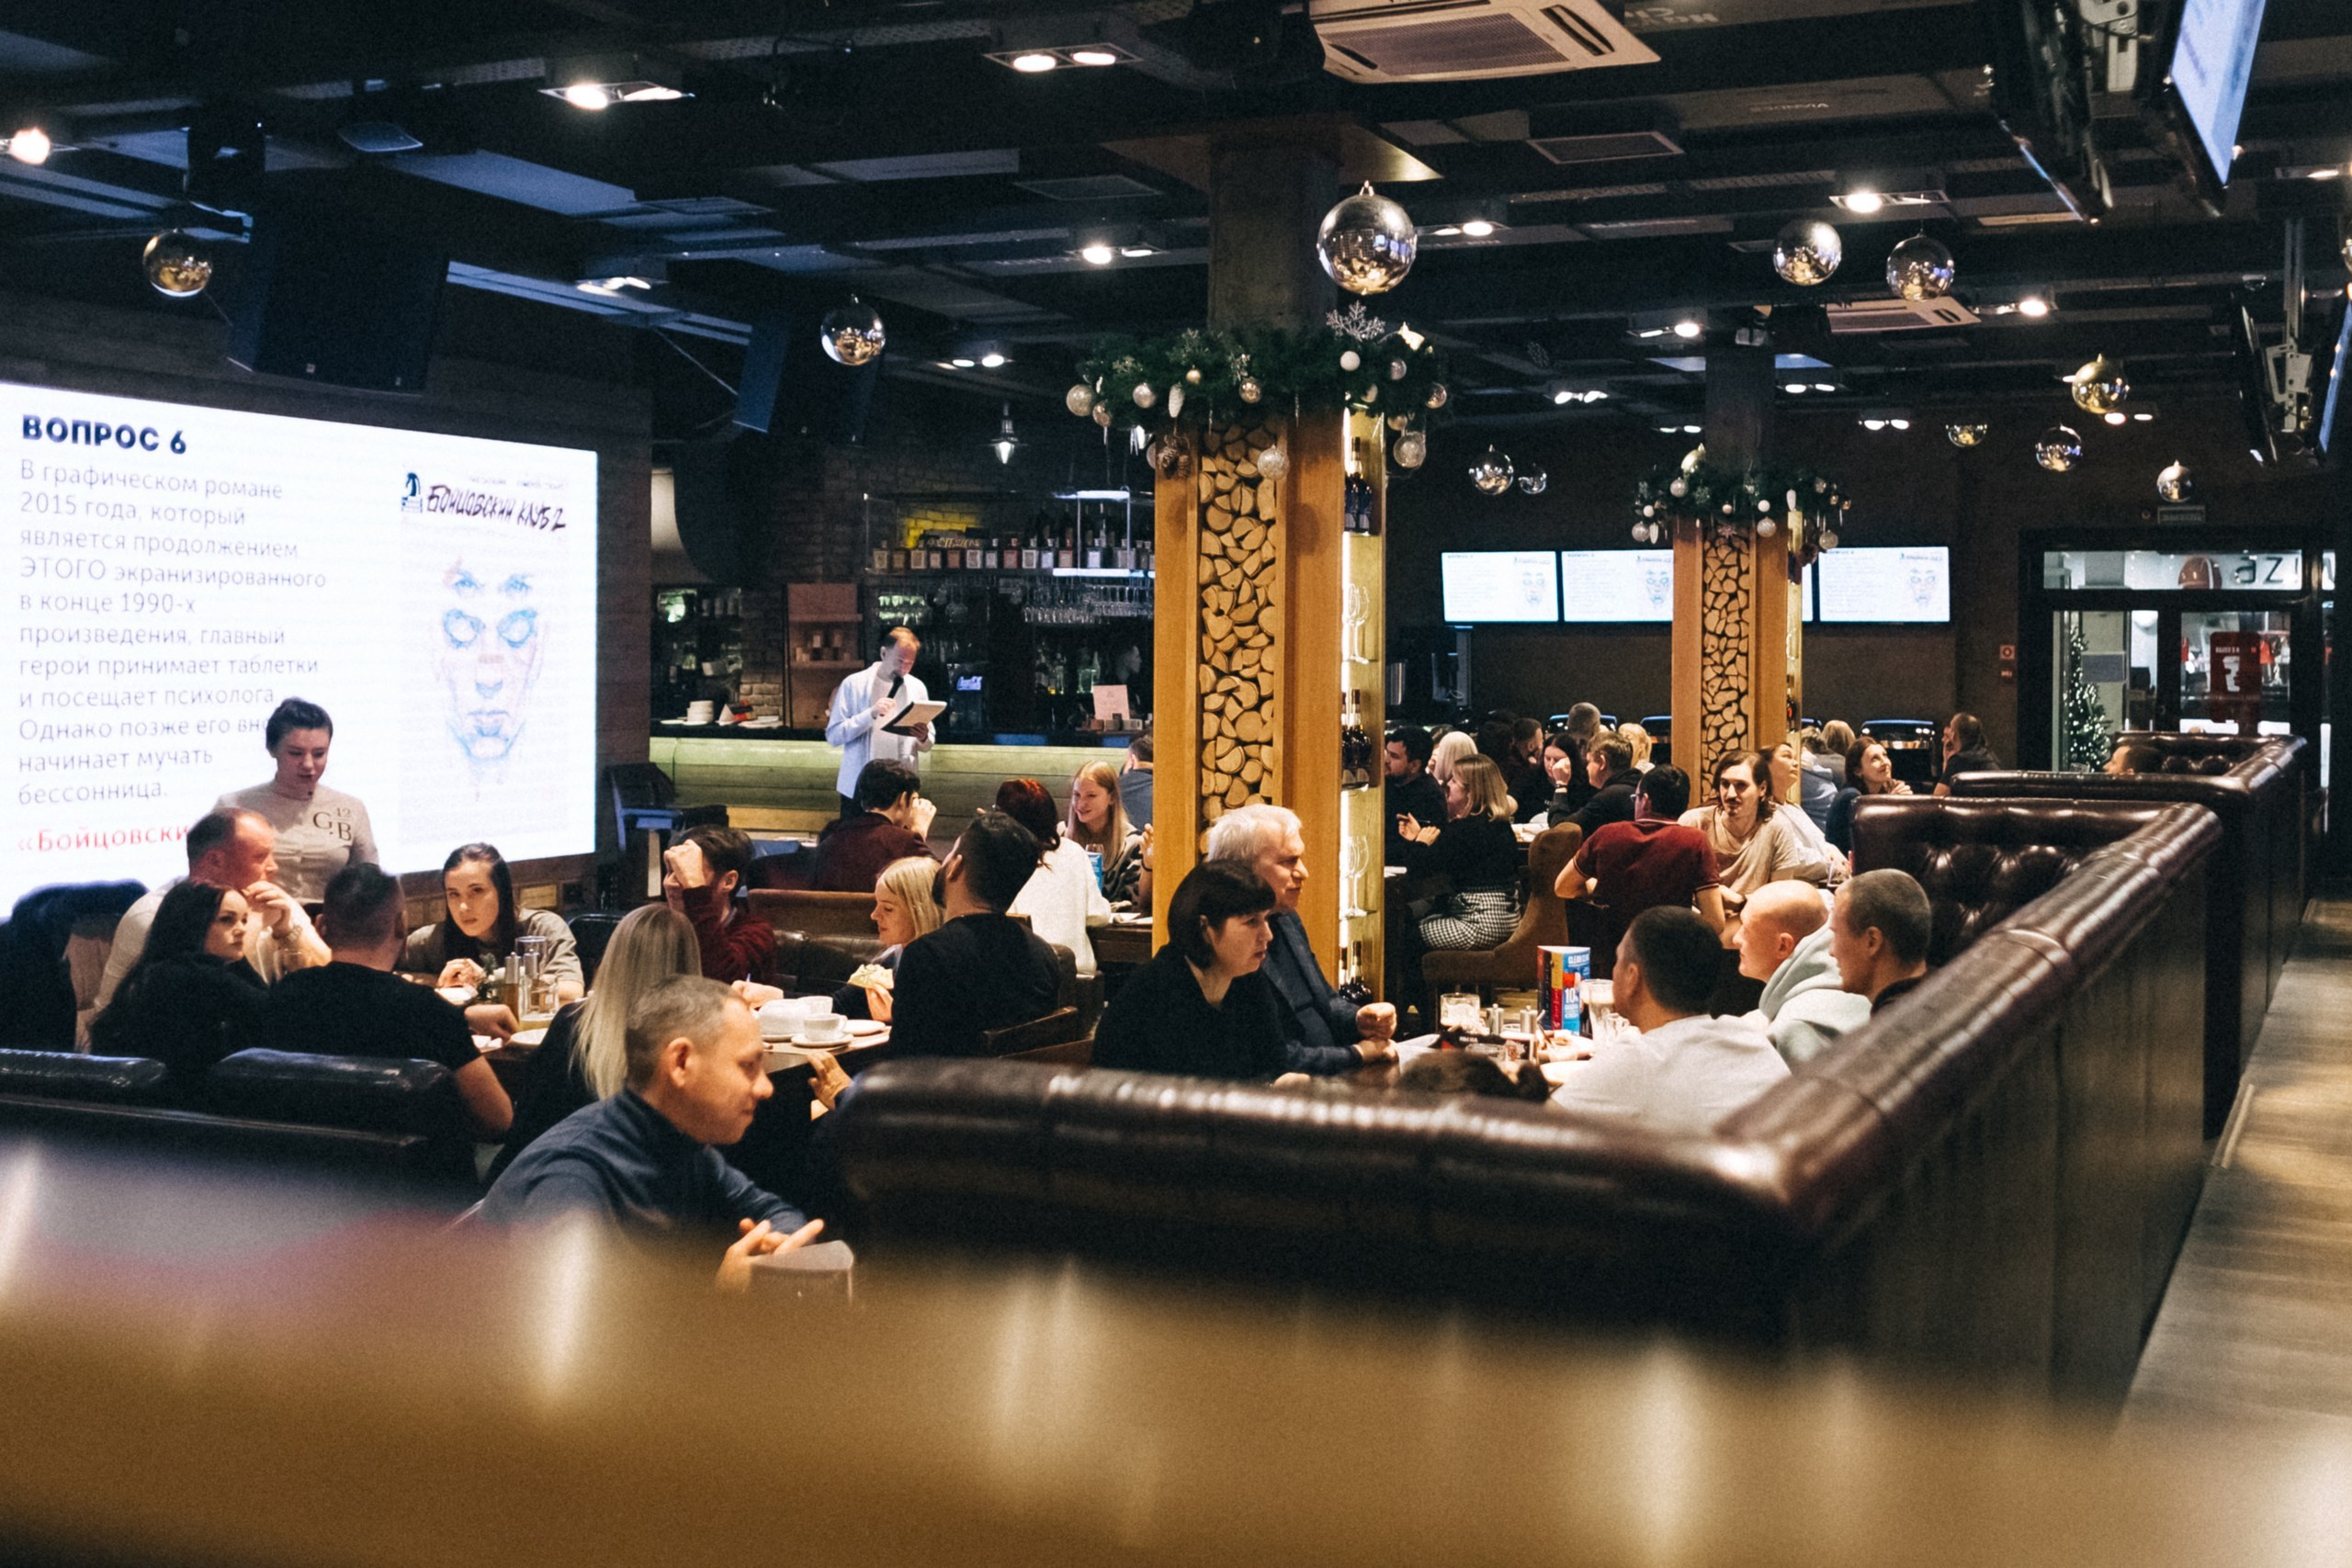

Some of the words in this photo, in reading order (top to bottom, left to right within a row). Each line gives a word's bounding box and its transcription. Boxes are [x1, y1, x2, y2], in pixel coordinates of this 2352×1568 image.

[22, 414, 160, 452] ВОПРОС
[169, 430, 187, 455] 6
[21, 458, 34, 479] В
[42, 465, 198, 492] графическом
[205, 479, 282, 499] романе
[21, 491, 76, 515] 2015
[85, 501, 142, 524] года,
[151, 505, 245, 528] который
[551, 507, 567, 531] 2
[21, 530, 125, 549] является
[134, 536, 297, 558] продолжением
[21, 557, 107, 580] ЭТОГО
[116, 567, 326, 589] экранизированного
[20, 594, 32, 611] в
[40, 596, 112, 615] конце
[122, 592, 195, 614] 1990-х
[20, 627, 191, 648] произведения,
[200, 626, 285, 645] главный
[19, 656, 89, 681] герой
[98, 660, 219, 680] принимает
[229, 653, 318, 674] таблетки
[20, 694, 32, 707] и
[42, 691, 156, 708] посещает
[19, 719, 112, 742] Однако
[120, 721, 188, 736] позже
[196, 719, 231, 735] его
[19, 752, 129, 772] начинает
[138, 750, 212, 771] мучать
[18, 783, 167, 805] бессонница.
[17, 825, 187, 852] «Бойцовски
